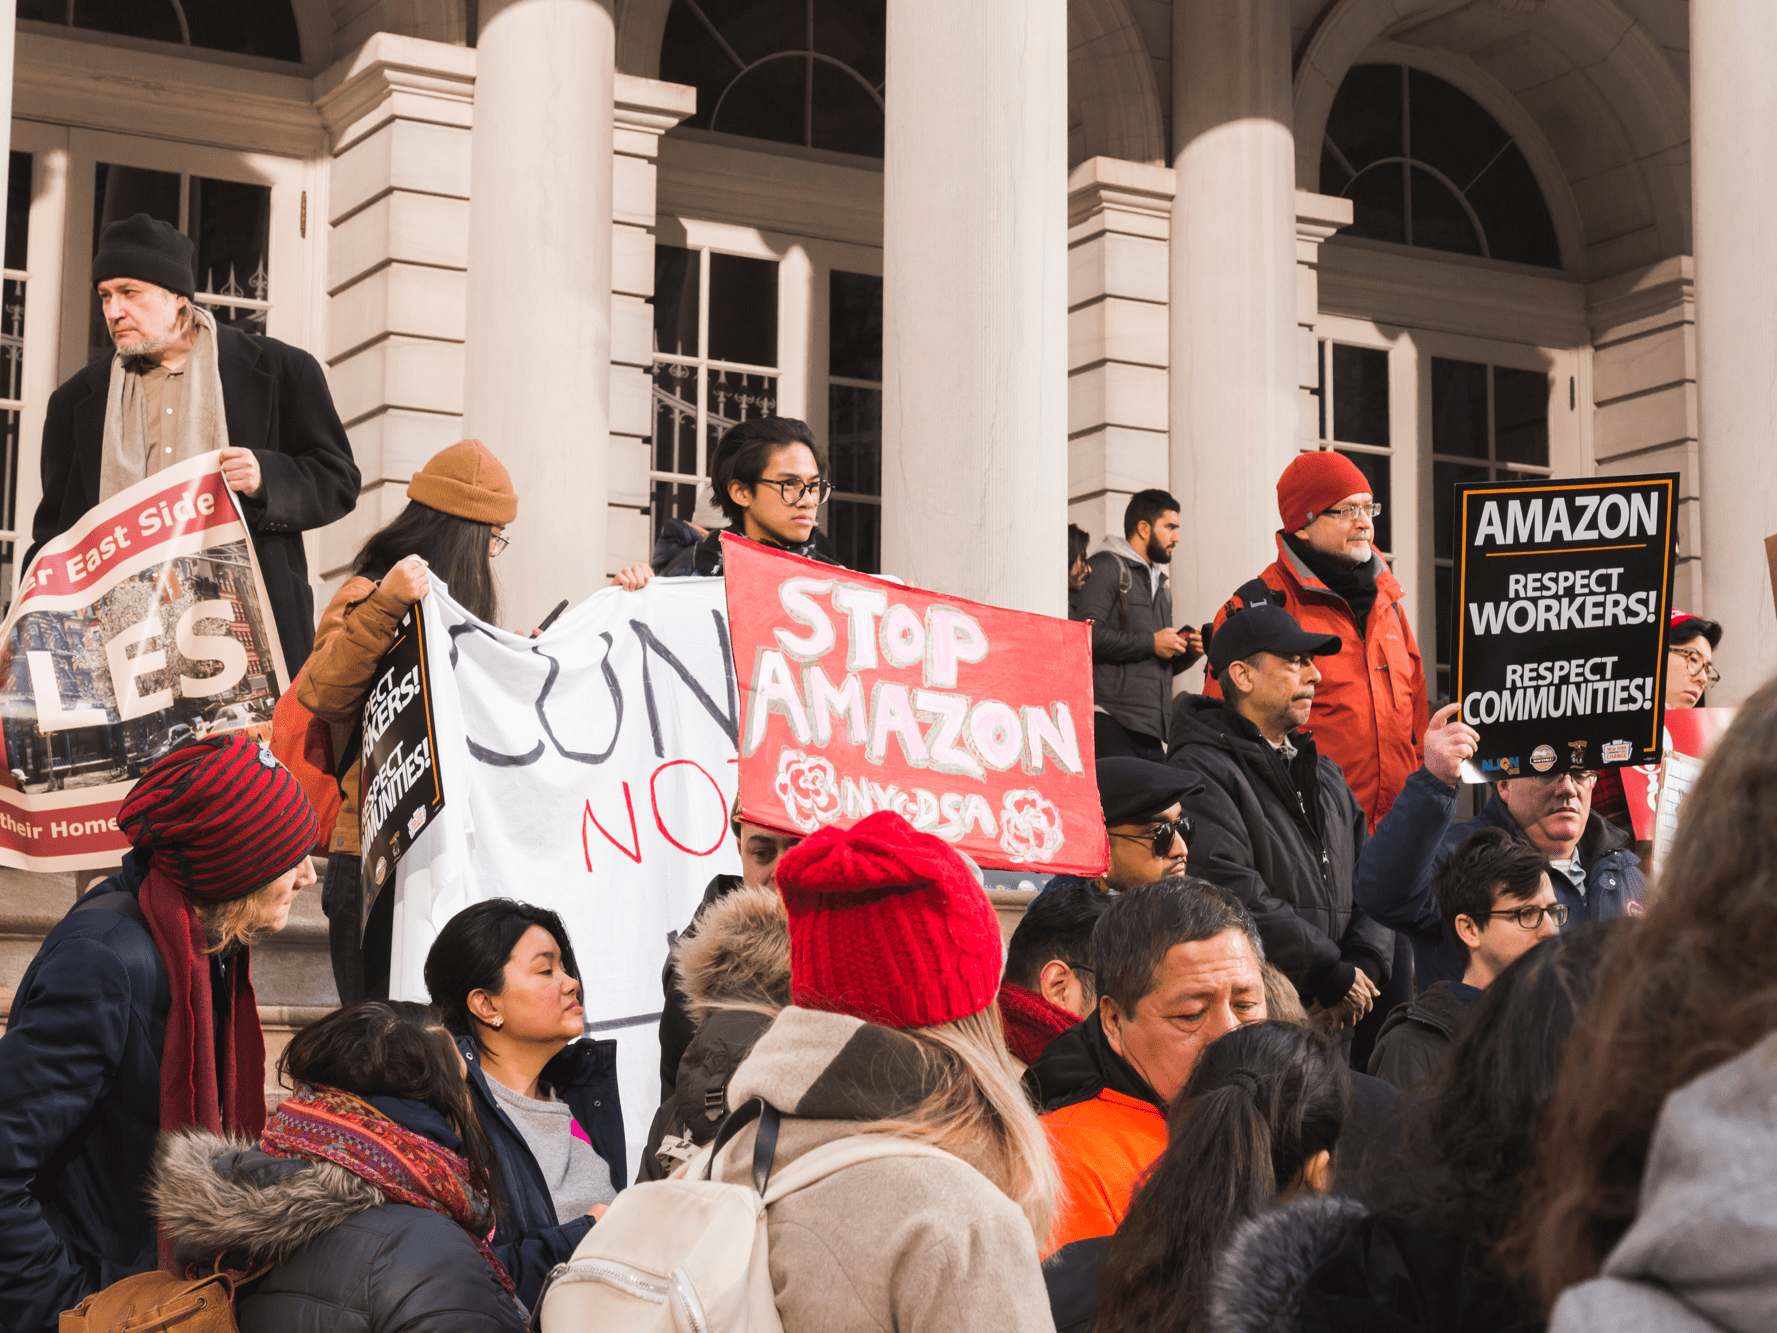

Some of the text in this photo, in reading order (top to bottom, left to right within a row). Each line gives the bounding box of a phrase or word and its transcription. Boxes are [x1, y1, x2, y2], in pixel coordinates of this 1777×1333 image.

[66, 525, 131, 583] East
[138, 491, 215, 537] Side
[1474, 491, 1659, 546] AMAZON
[1508, 567, 1624, 598] RESPECT
[773, 576, 989, 688] STOP
[1469, 590, 1657, 636] WORKERS!
[27, 599, 248, 733] LES
[1505, 656, 1618, 688] RESPECT
[742, 645, 1085, 784] AMAZON
[1463, 677, 1654, 725] COMMUNITIES!
[0, 812, 42, 839] their
[582, 759, 739, 873] NO
